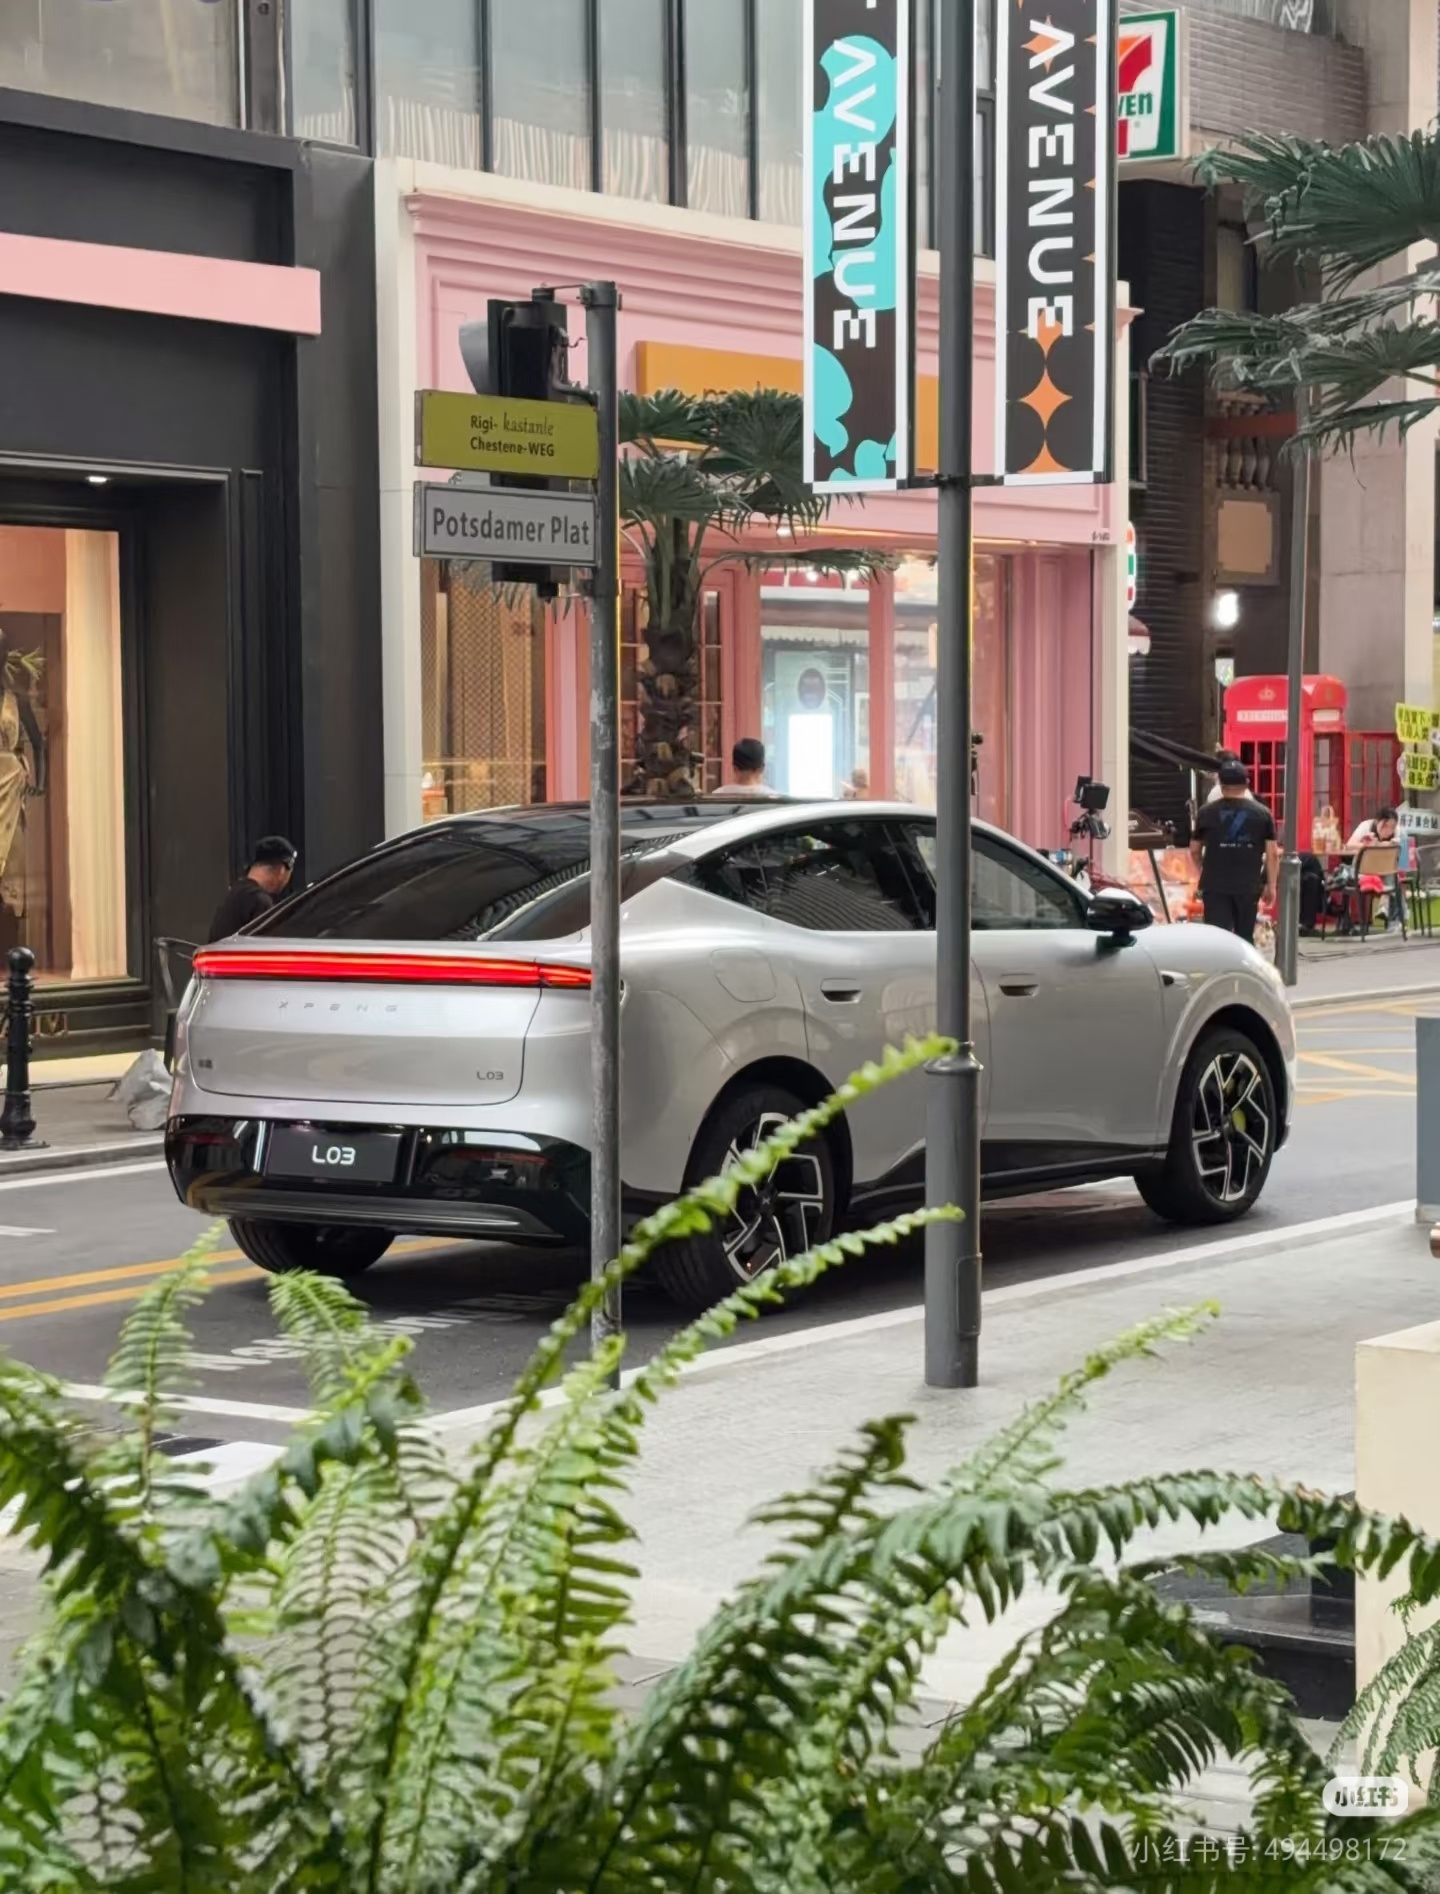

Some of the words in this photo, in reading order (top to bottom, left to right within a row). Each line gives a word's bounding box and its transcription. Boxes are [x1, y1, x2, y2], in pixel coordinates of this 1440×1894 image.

[833, 39, 877, 350] AVENUE
[1027, 19, 1075, 340] AVENUE
[470, 414, 498, 434] Rigi-
[433, 507, 545, 543] Potsdamer
[551, 515, 590, 545] Plat
